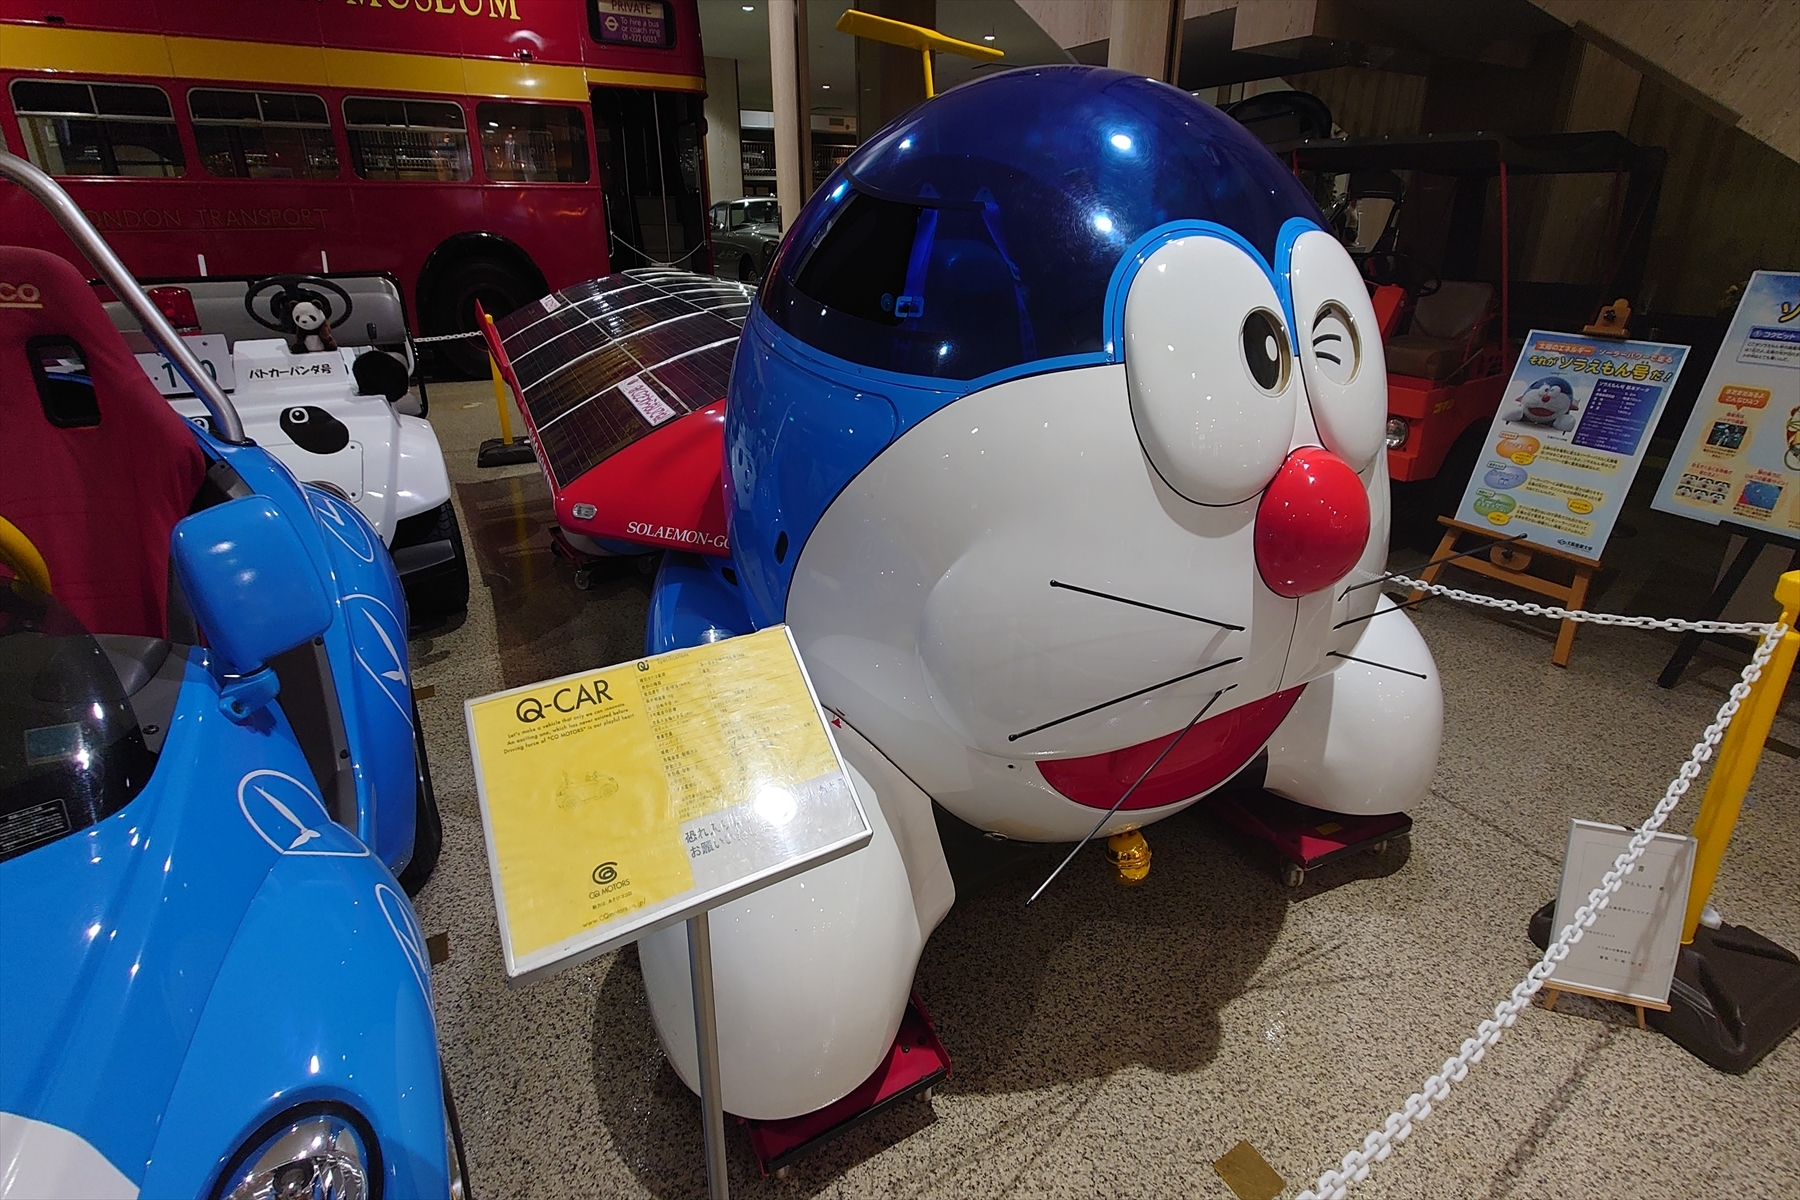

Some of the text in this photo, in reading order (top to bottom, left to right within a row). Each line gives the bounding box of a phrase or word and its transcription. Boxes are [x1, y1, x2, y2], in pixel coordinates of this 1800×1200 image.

[611, 0, 652, 15] PRIVATE
[621, 17, 629, 25] To
[630, 18, 642, 27] hire
[648, 20, 660, 28] bus
[629, 25, 648, 35] coach
[649, 27, 661, 37] ring
[84, 207, 329, 229] ONDON TRANSPORT
[1537, 343, 1592, 354] 太陽のエネルギー
[249, 362, 332, 379] パトカーパンダ号
[516, 679, 614, 723] Q-CAR
[517, 735, 538, 743] exciting
[552, 725, 567, 733] which
[594, 712, 612, 721] existed
[543, 721, 561, 729] vehicle
[503, 746, 524, 755] Driving
[603, 716, 621, 726] playful
[589, 879, 631, 900] CQ MOTORS
